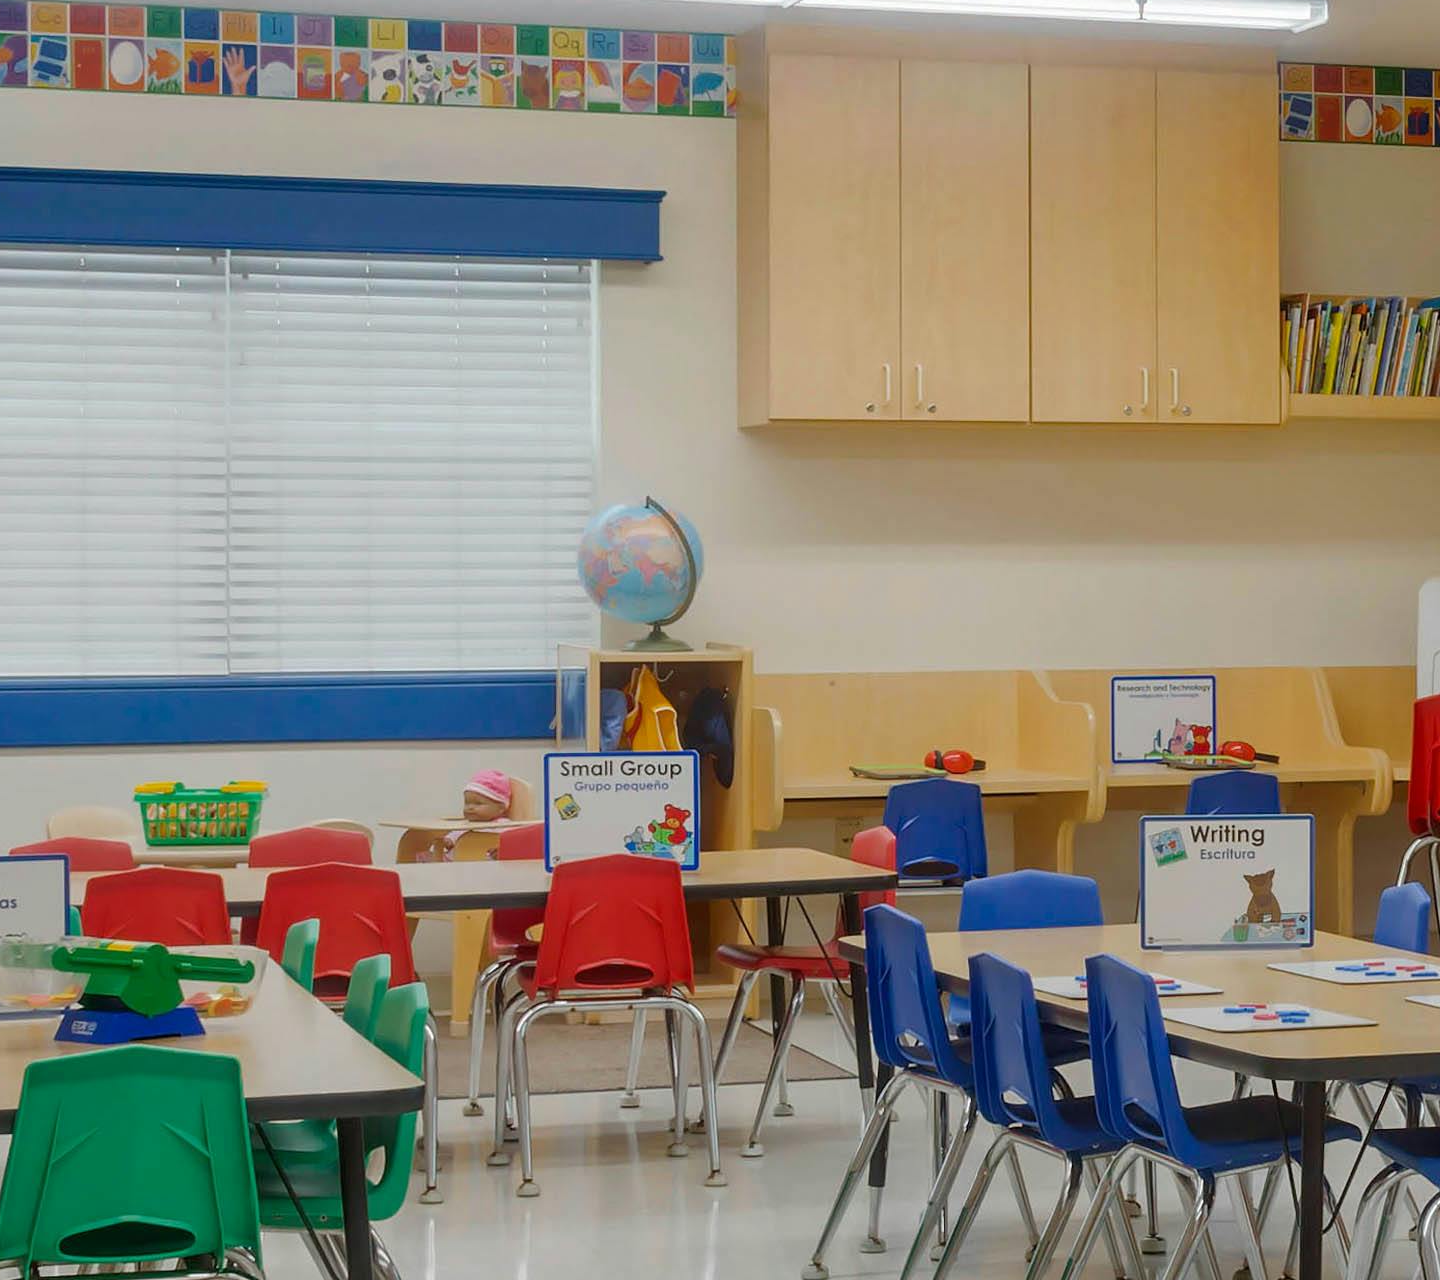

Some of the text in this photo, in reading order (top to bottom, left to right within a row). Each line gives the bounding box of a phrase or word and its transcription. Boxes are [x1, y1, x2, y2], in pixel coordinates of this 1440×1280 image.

[559, 759, 683, 780] Small Group
[573, 779, 670, 793] Grupo pequeño
[1189, 824, 1266, 848] Writing
[1199, 847, 1257, 861] Escritura
